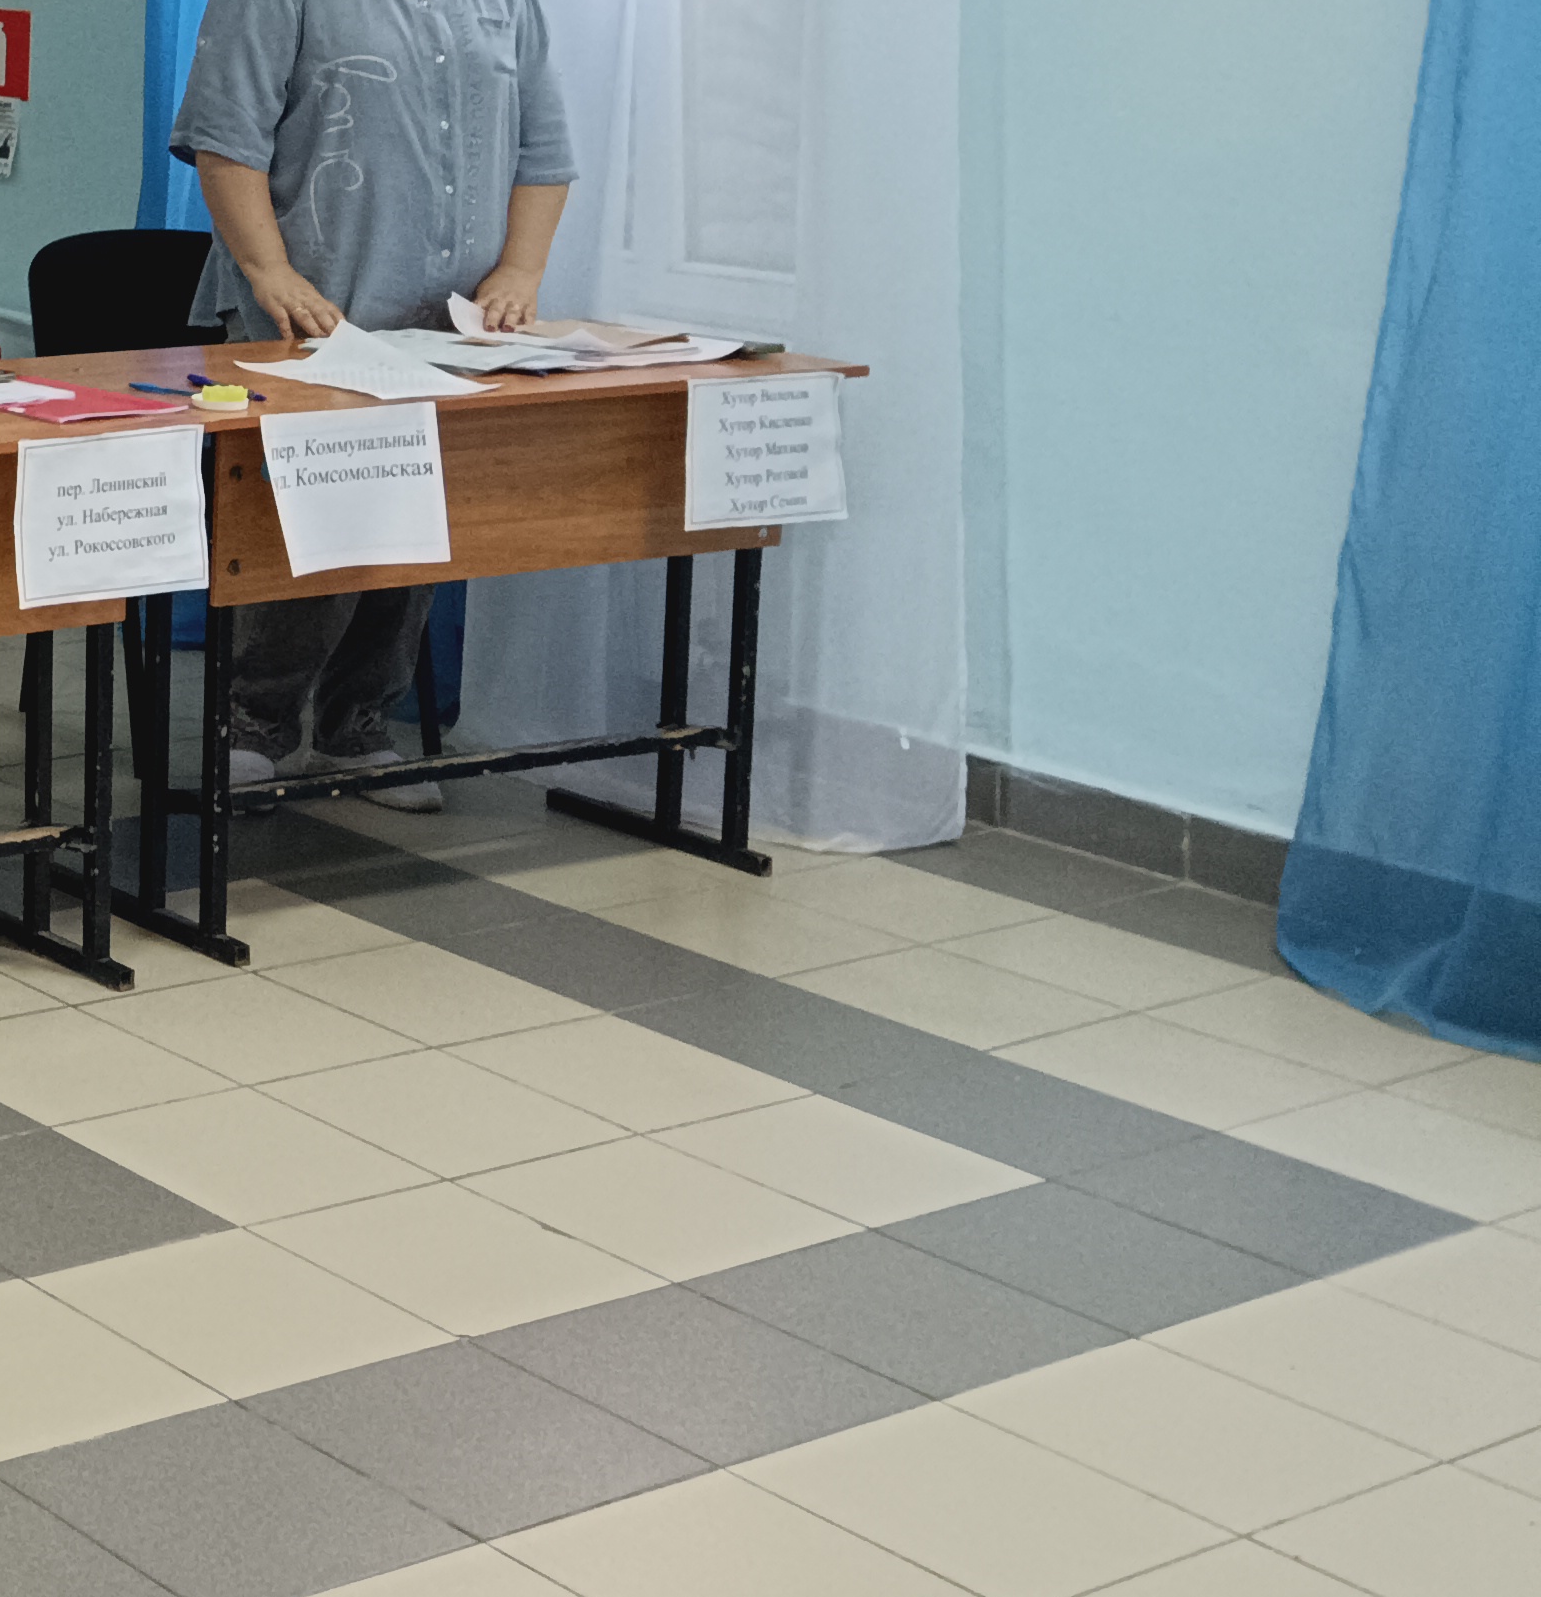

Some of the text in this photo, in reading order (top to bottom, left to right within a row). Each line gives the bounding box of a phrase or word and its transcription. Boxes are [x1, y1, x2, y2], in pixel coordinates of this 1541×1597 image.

[271, 429, 426, 463] пер. Коммунальный
[57, 472, 167, 499] пер. Ленинский
[296, 461, 433, 487] Комсомольская
[57, 505, 168, 531] ул. Набережная
[49, 531, 175, 561] ул. Рокоссовского
